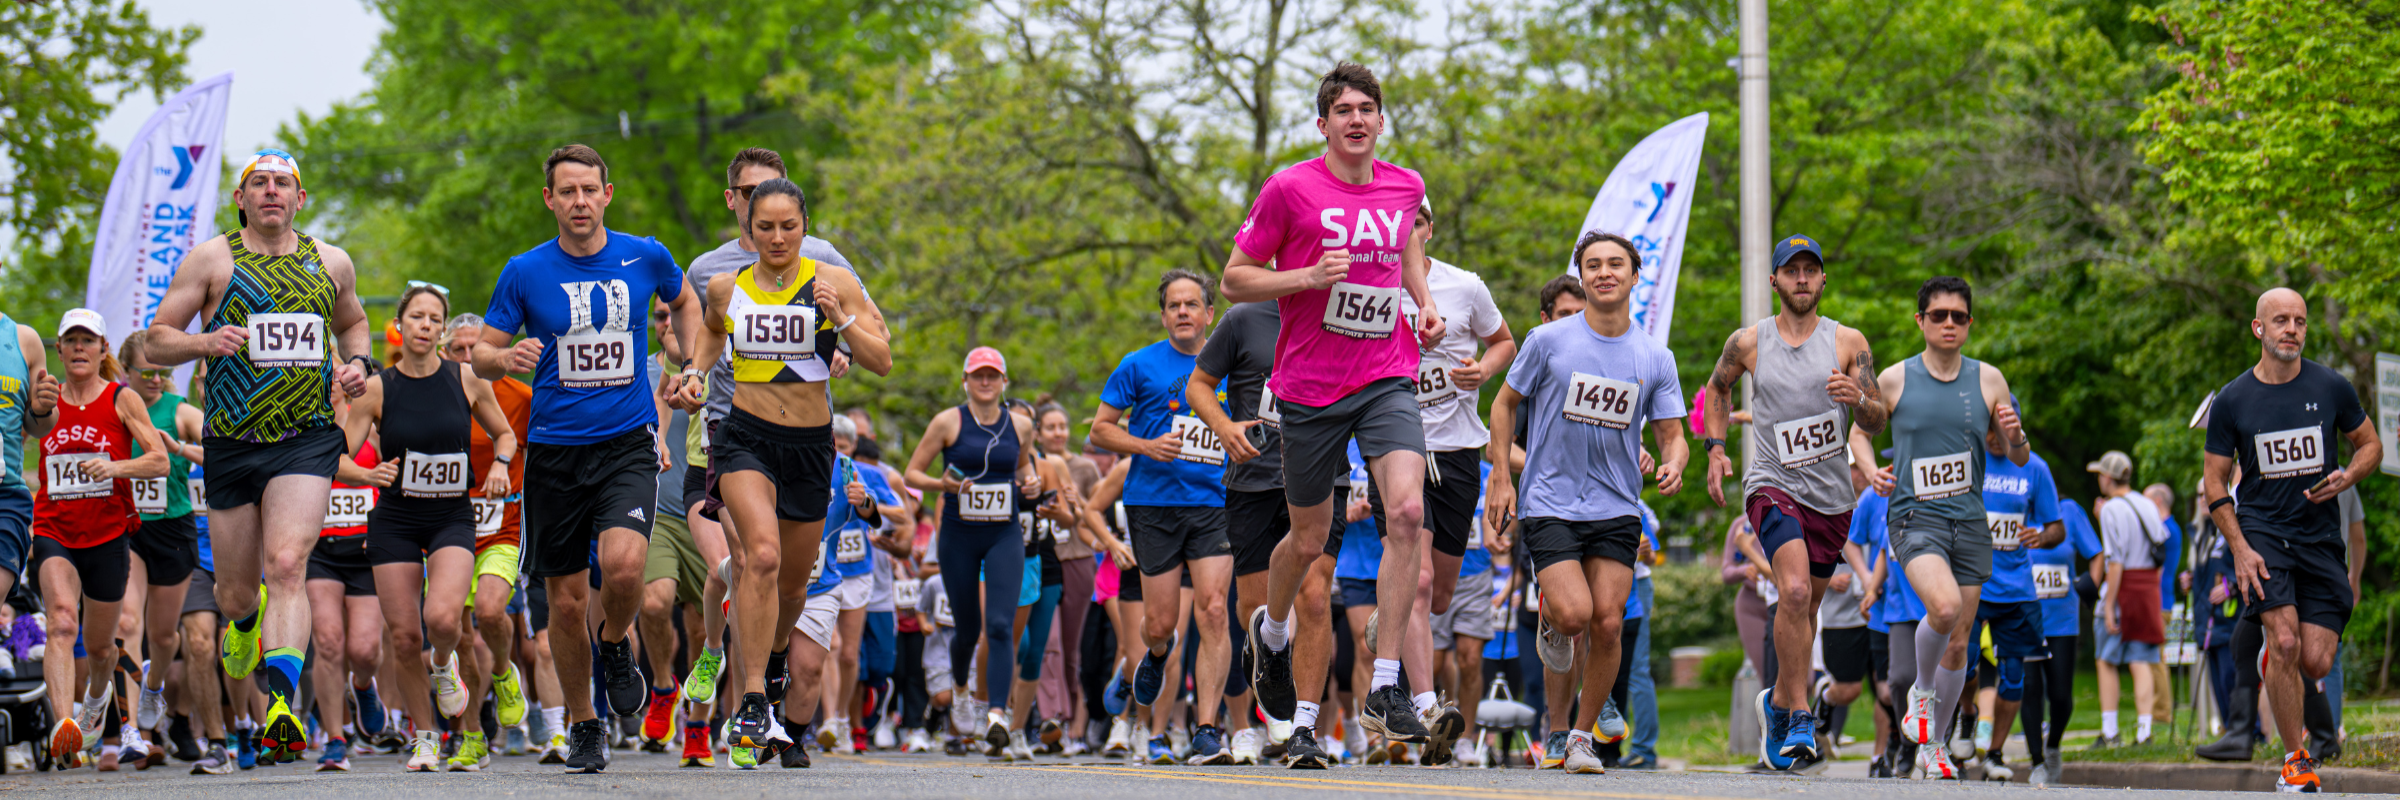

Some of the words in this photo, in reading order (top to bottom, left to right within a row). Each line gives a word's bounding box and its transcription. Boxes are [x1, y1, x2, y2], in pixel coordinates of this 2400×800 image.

[149, 203, 174, 265] AND
[1321, 208, 1403, 247] SAY
[1377, 251, 1399, 263] Team
[143, 275, 169, 330] OVE
[1336, 291, 1392, 323] 1564
[256, 322, 315, 351] 1594
[745, 314, 804, 343] 1530
[1325, 324, 1363, 338] TRISTATE
[567, 341, 625, 371] 1529
[739, 352, 777, 360] TRISTATE
[0, 376, 21, 394] URN
[563, 379, 601, 388] TRISTATE
[603, 378, 632, 386] TIMING
[1168, 374, 1191, 397] SUPE
[1419, 367, 1446, 394] 63
[1575, 382, 1628, 415] 1496
[1565, 414, 1600, 426] TRISTATE
[1601, 420, 1627, 429] TIMING
[44, 425, 111, 455] ESSEX
[1782, 420, 1836, 454] 1452
[1785, 458, 1818, 469] TRISTATE
[1819, 449, 1842, 461] TIMING
[2264, 435, 2316, 465] 1560
[411, 460, 461, 485] 1430
[1920, 461, 1965, 487] 1623
[2264, 470, 2297, 479] TRISTATE
[85, 490, 110, 498] TIMING
[135, 480, 158, 501] 95
[404, 490, 437, 498] TRISTATE
[968, 490, 1005, 510] 1579
[474, 503, 497, 524] 87
[2036, 570, 2062, 588] 418
